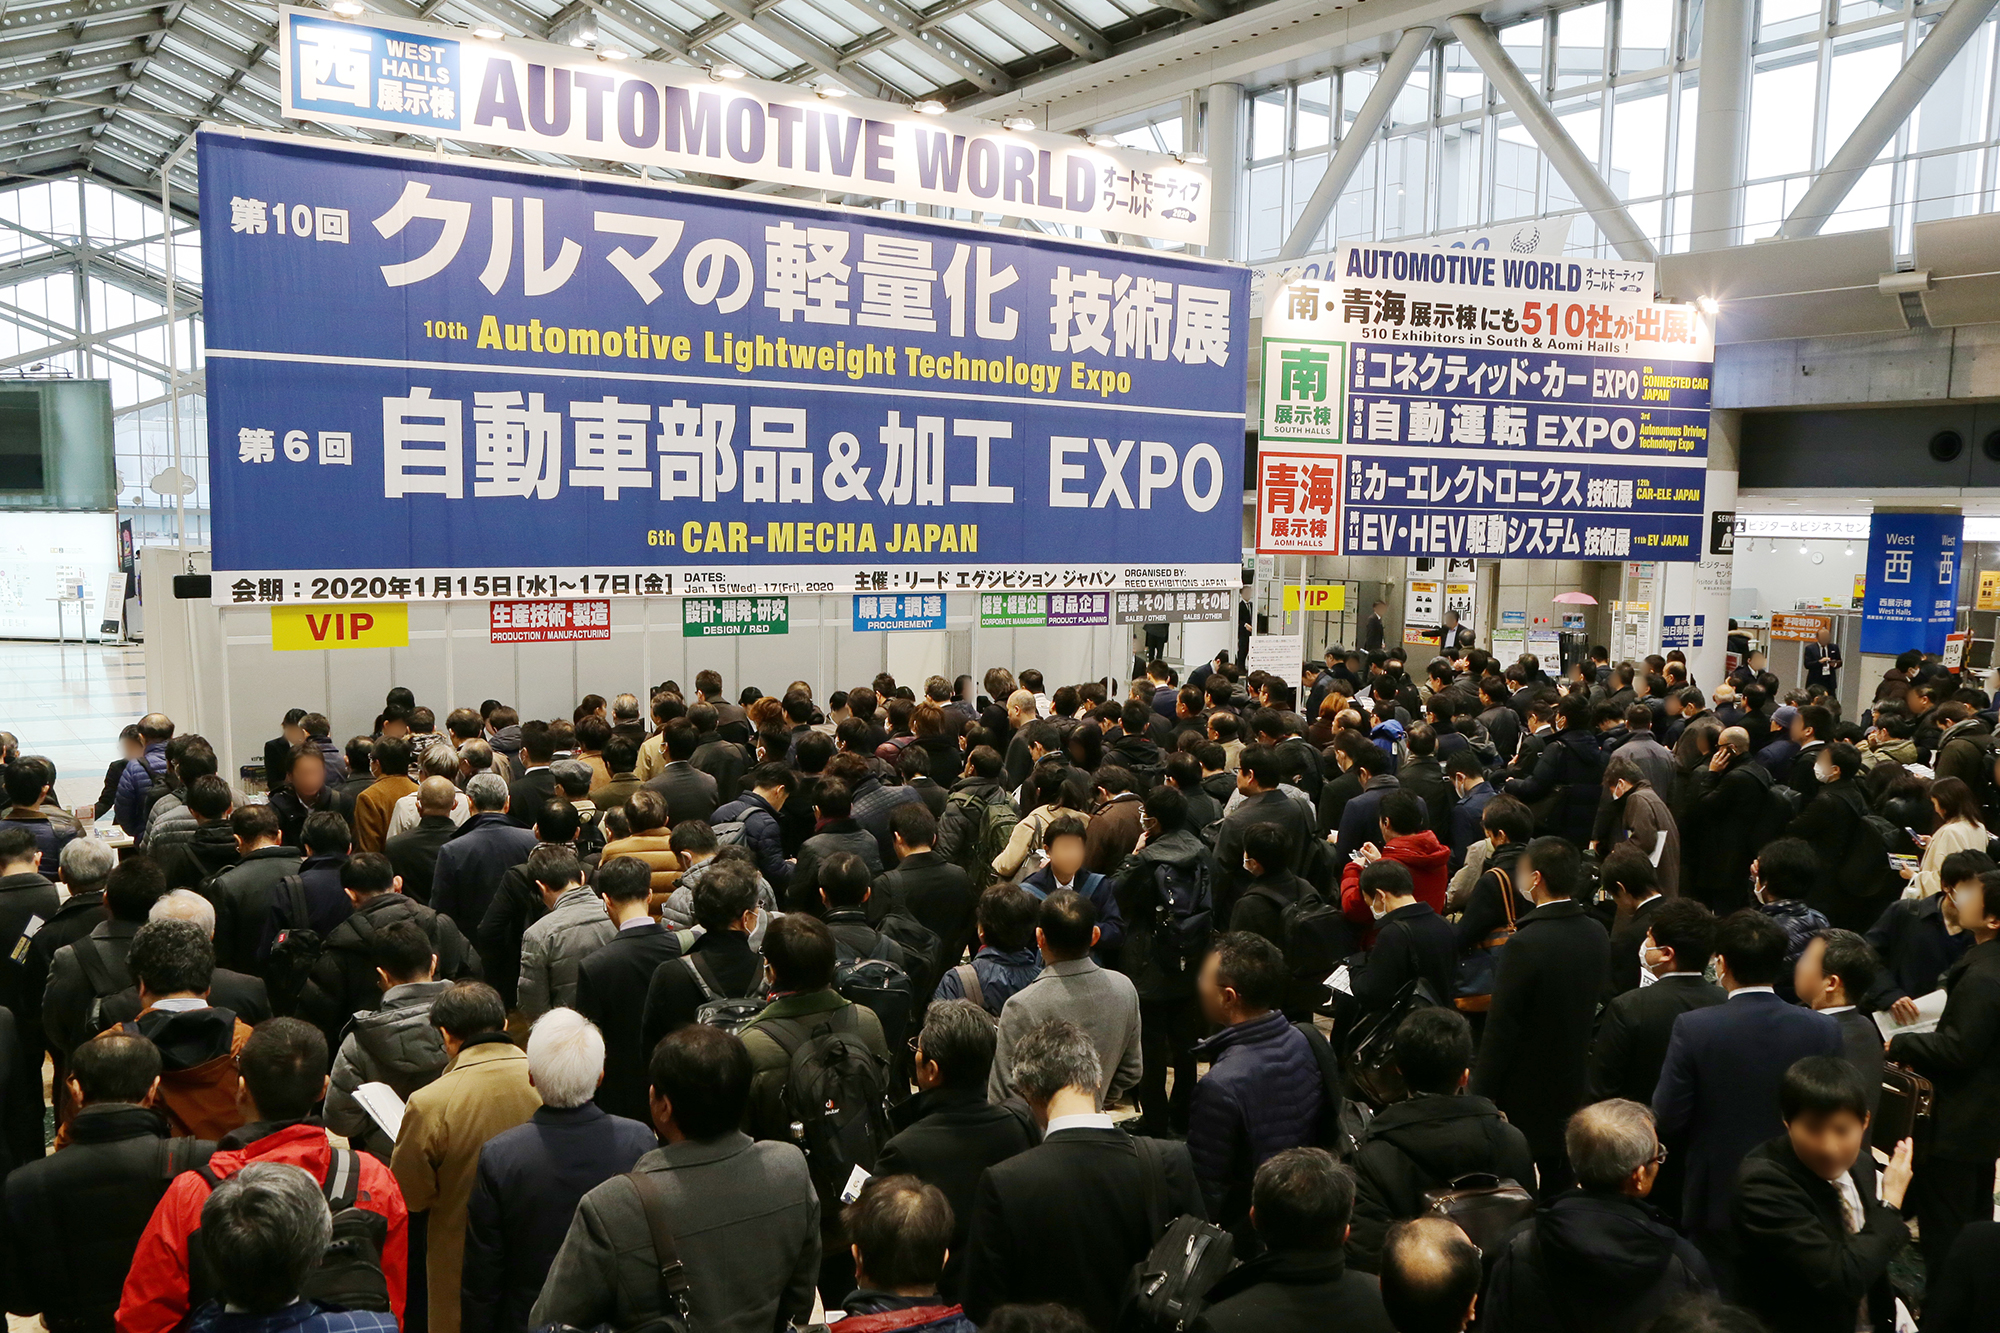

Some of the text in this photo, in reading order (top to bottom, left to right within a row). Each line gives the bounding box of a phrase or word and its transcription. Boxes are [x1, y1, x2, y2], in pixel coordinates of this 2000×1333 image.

[386, 38, 446, 64] WEST
[296, 25, 372, 108] 西
[381, 58, 450, 85] HALLS
[376, 78, 456, 120] 展示棟
[474, 57, 1095, 214] AUTOMOTIVE WORLD
[1103, 166, 1202, 202] オートモーティブ
[1103, 191, 1154, 218] ワールド
[1172, 208, 1190, 220] 2020
[229, 180, 1233, 368] 第10回 クルマの軽量化 技術展
[1345, 247, 1496, 287] AUTOMOTIVE
[1503, 257, 1582, 293] WORLD
[1585, 267, 1645, 282] オートモーティブ
[1585, 279, 1616, 293] ワールド
[1362, 328, 1388, 340] 510
[1392, 329, 1465, 345] Exhibitors
[1469, 333, 1482, 345] in
[1487, 335, 1528, 348] South
[1532, 337, 1543, 349] &
[1547, 338, 1583, 351] Aomi
[1587, 341, 1620, 353] Halls
[423, 314, 1132, 398] 10th Automotive Lightweight Technology Expo
[1280, 348, 1330, 402] 南
[1368, 351, 1588, 398] コネクティッド・カー
[1592, 368, 1640, 400] EXPO
[1642, 374, 1710, 391] CONNECTED CAR
[1641, 388, 1670, 401] JAPAN
[1274, 404, 1332, 426] 展示棟
[1640, 412, 1651, 421] 3rd
[1274, 426, 1331, 435] SOUTH HALLS
[1367, 399, 1528, 447] 自動運転
[1536, 414, 1636, 450] EXPO
[1639, 422, 1708, 440] Autonomous Driving
[237, 386, 1225, 514] 第6回 自動車部品&加工 EXPO
[1639, 436, 1695, 453] Technology Expo
[1265, 463, 1335, 516] 青海
[1363, 462, 1584, 507] カーエレクトロニクス
[1586, 478, 1634, 509] 技術展
[1636, 478, 1650, 487] 12th
[1636, 487, 1701, 501] CAR-ELE JAPAN
[1270, 517, 1328, 539] 展示棟
[1748, 520, 1870, 533] ビジター&ビジネスセン
[647, 520, 979, 554] 6th CAR-MECHA JAPAN
[1274, 539, 1295, 547] AOMI
[1583, 526, 1632, 557] 技術展
[1633, 534, 1689, 547] 11th EV JAPAN
[1886, 533, 1916, 546] West
[1941, 535, 1956, 547] West
[1124, 568, 1187, 577] ORGANISED BY:
[1884, 550, 1914, 584] 西
[1938, 551, 1955, 585] 西
[684, 573, 727, 583] DATES:
[956, 570, 1058, 589] エグジビション
[1063, 569, 1117, 588] ジャパン
[1124, 578, 1228, 588] REED EXHIBITIONS JAPAN
[684, 584, 708, 594] Jan.
[806, 582, 834, 592] 2020
[1051, 593, 1106, 614] 商品企画
[1296, 590, 1329, 606] VIP
[1124, 615, 1144, 623] SALES
[1147, 614, 1167, 622] OTHER
[1878, 607, 1912, 616] West Halls
[305, 612, 374, 642] VIP
[867, 619, 933, 630] PROCUREMENT
[981, 617, 1046, 626] CORPORATE MANAGEMENT
[1048, 616, 1108, 625] PRODUCT PLANNING
[491, 631, 542, 642] PRODUCTION
[547, 629, 609, 641] MANUFACTURING
[703, 625, 741, 635] DESIGN
[749, 624, 770, 634] R&D
